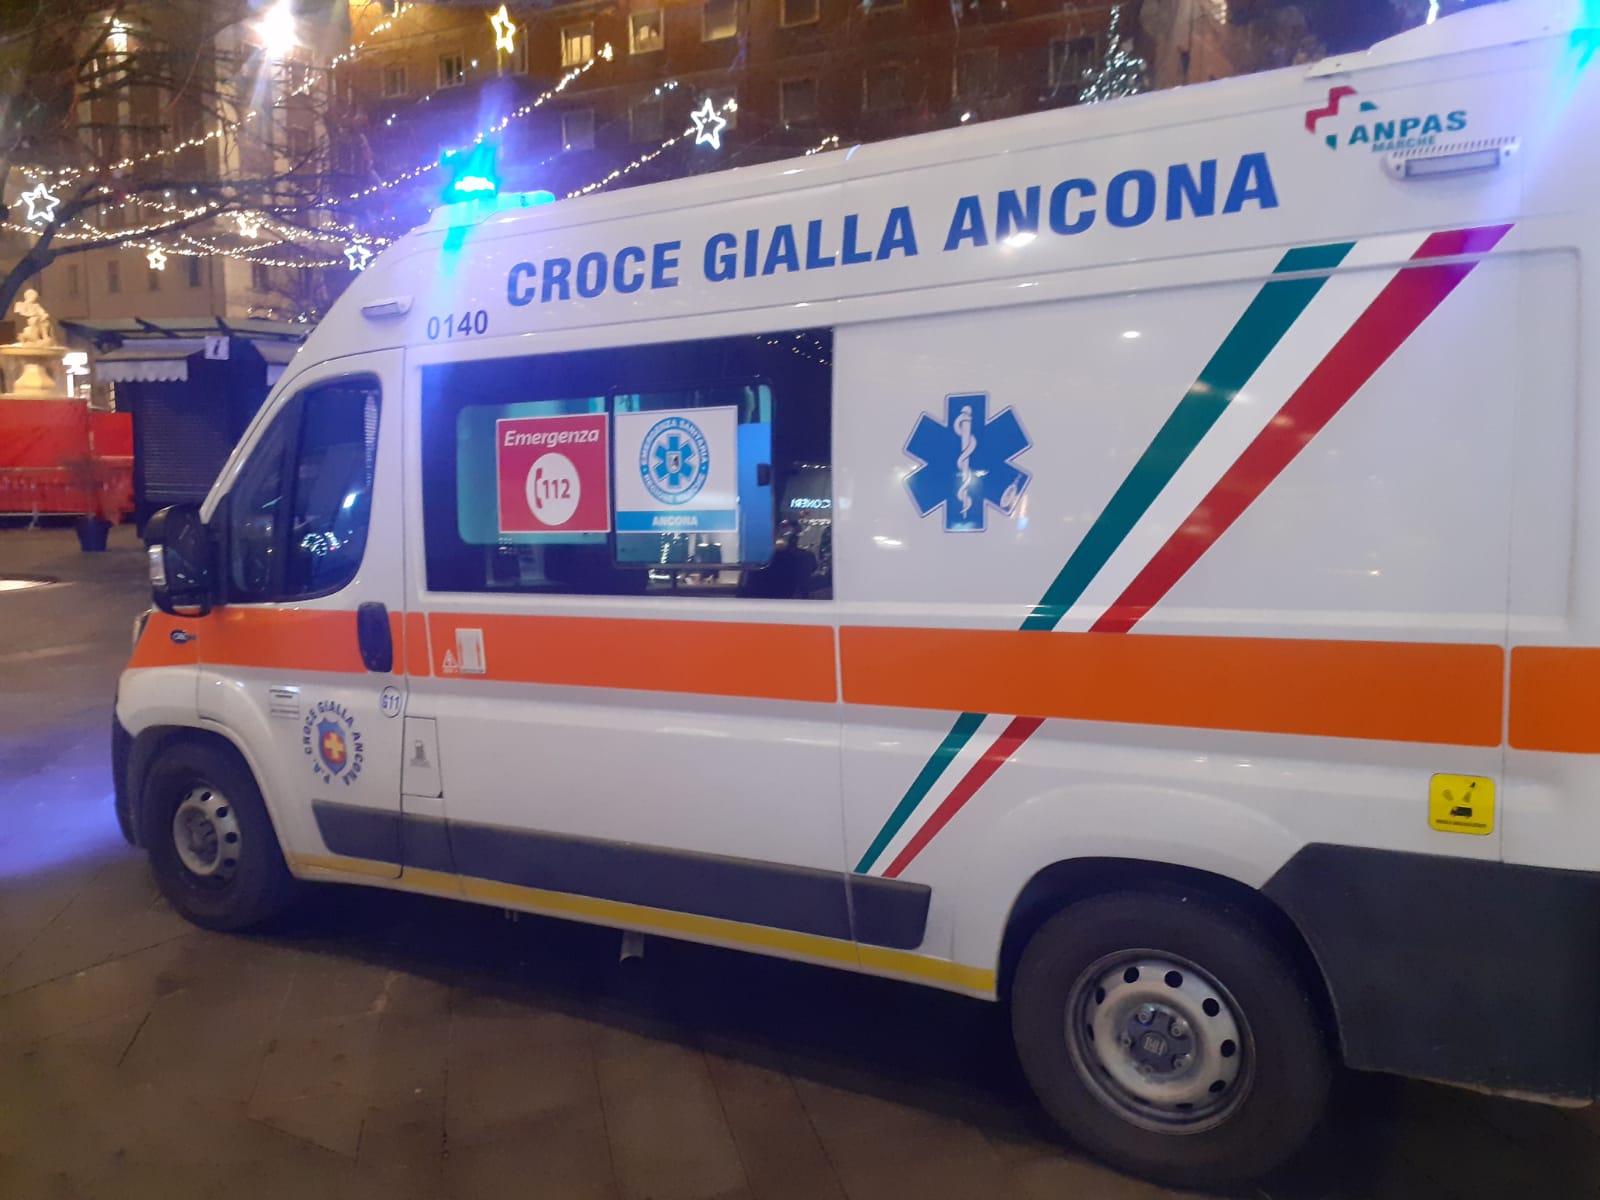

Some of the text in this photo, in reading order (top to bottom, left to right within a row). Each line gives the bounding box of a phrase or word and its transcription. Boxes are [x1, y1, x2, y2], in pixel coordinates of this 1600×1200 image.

[1348, 110, 1467, 145] ANPAS
[1372, 135, 1436, 152] MARCHE
[507, 152, 1279, 307] CROCE GIALLA ANCONA
[427, 309, 488, 340] 0140
[503, 429, 600, 448] Emergenza
[542, 478, 570, 499] 112
[652, 515, 698, 527] ANCONA
[303, 708, 317, 755] CROCE
[317, 701, 354, 728] GIALLA
[341, 732, 364, 786] ANCONA
